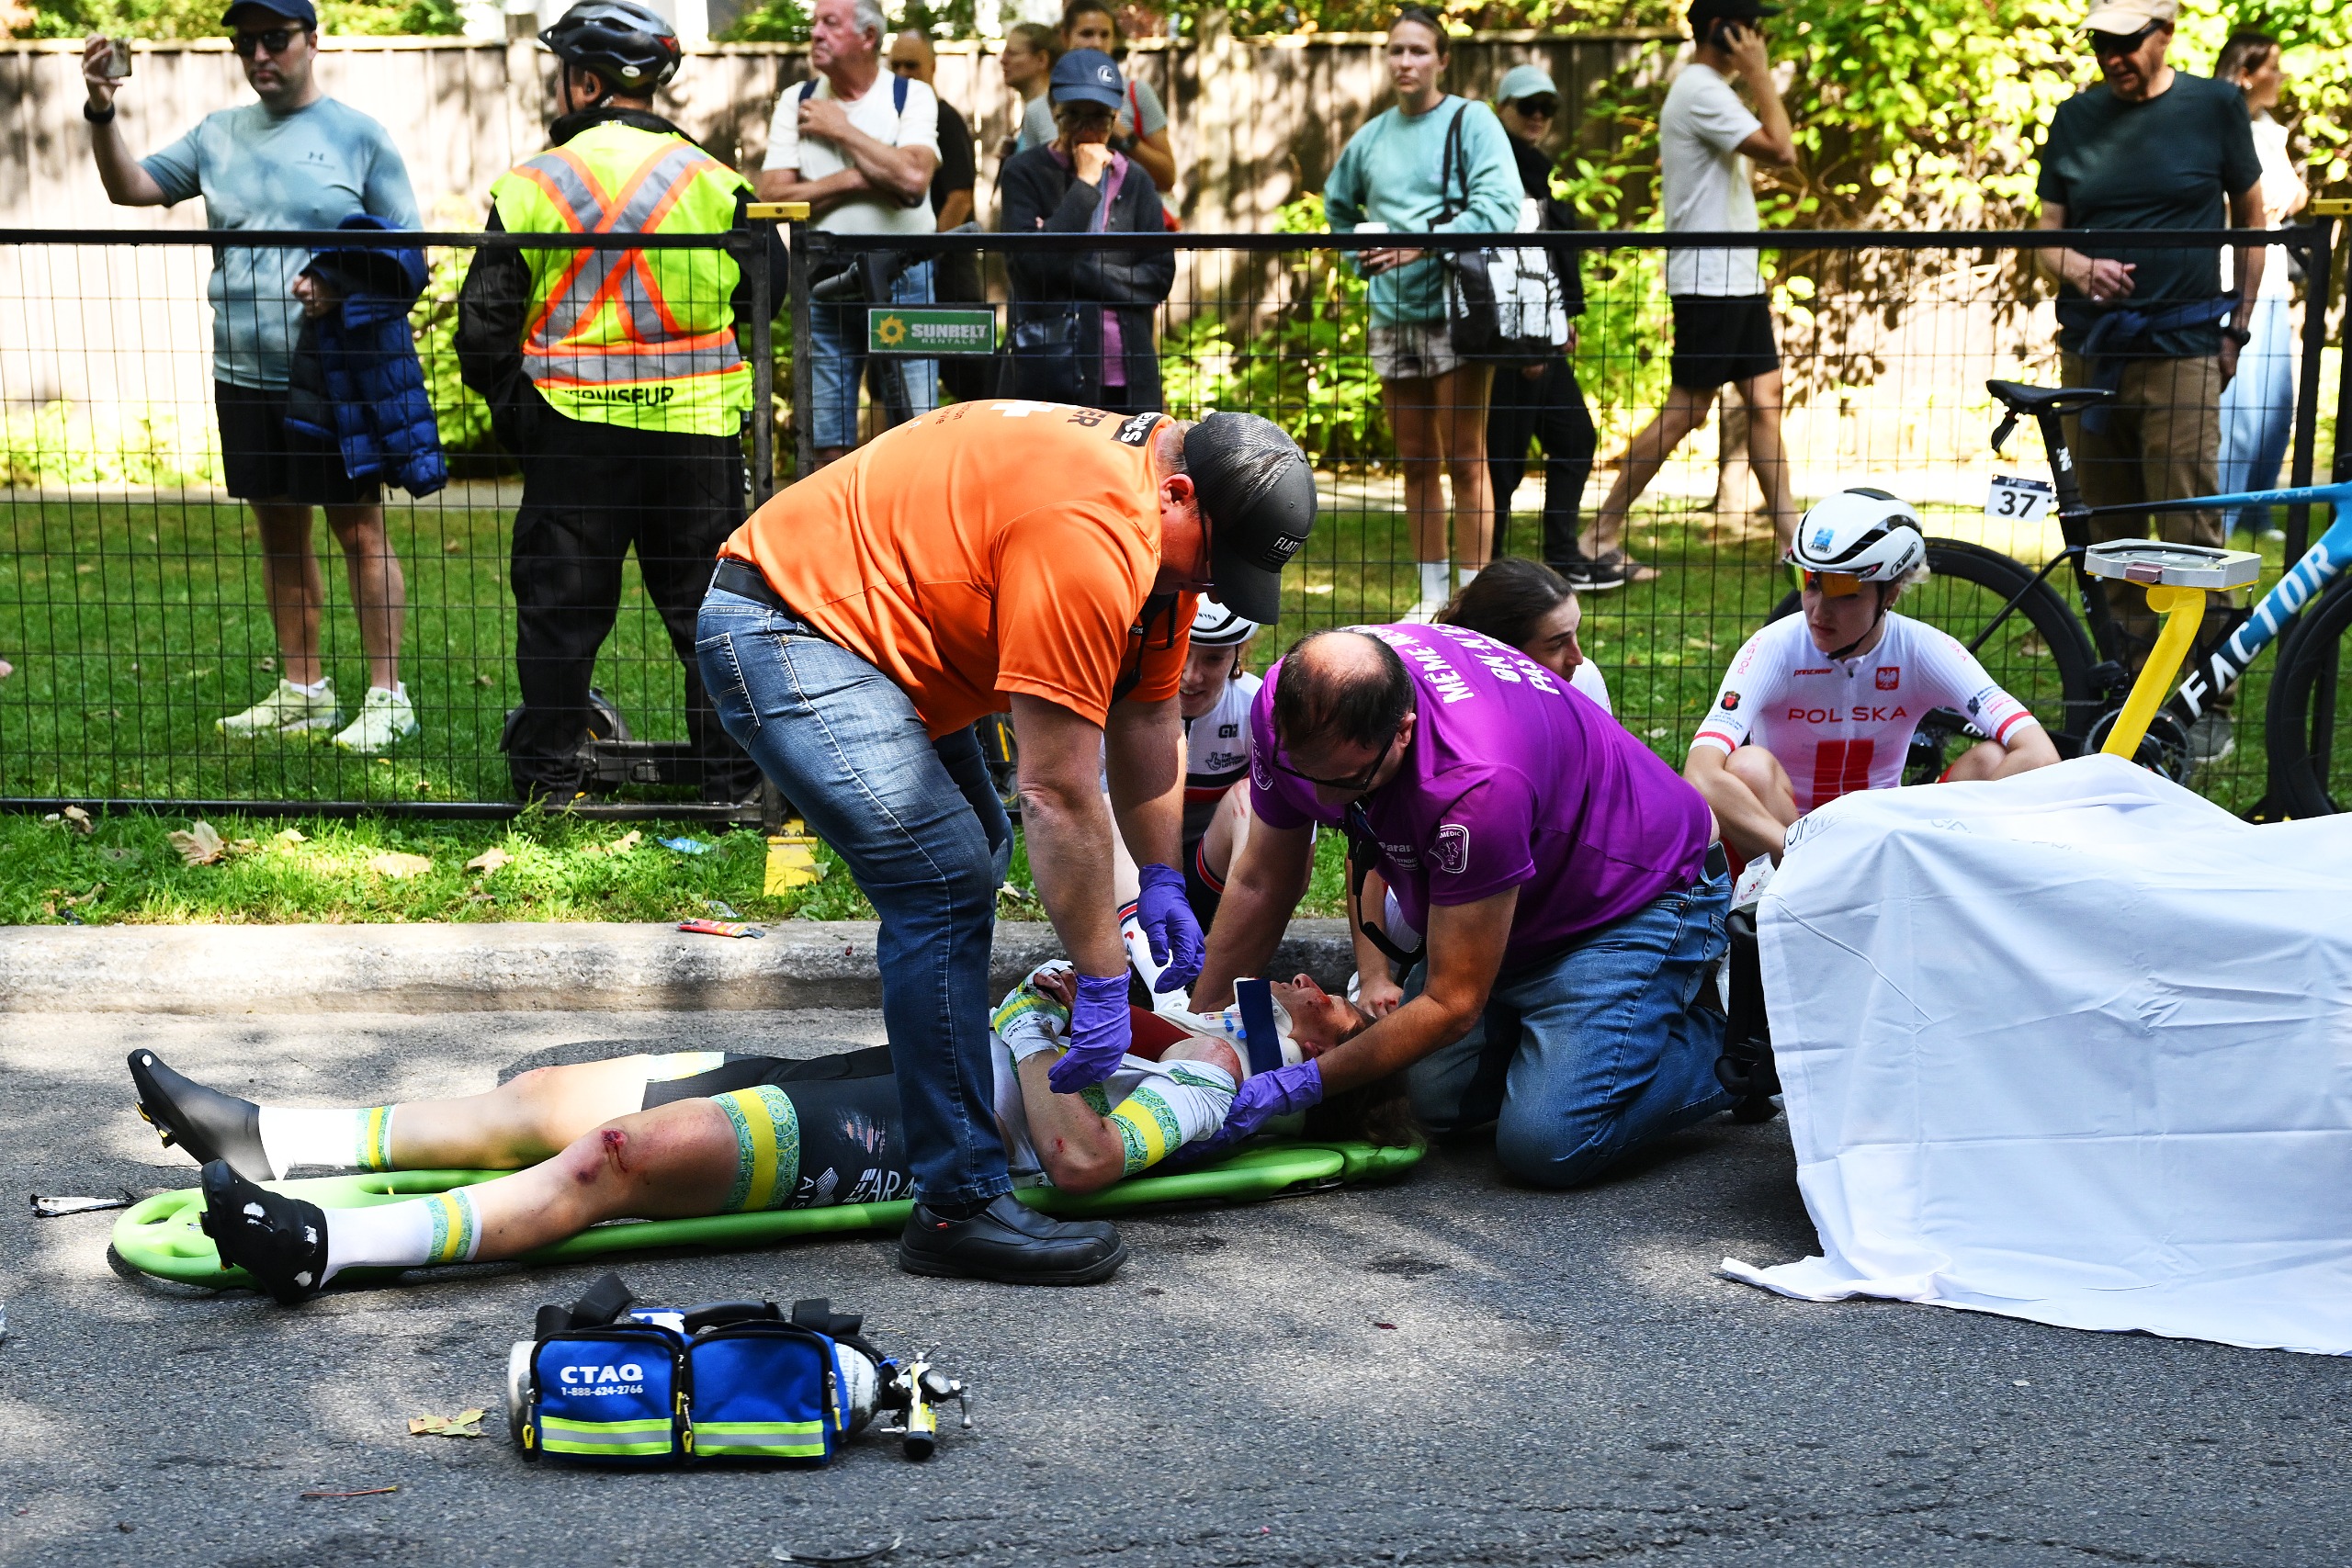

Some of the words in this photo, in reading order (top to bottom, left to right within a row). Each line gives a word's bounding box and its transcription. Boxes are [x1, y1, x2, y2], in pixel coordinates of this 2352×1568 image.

[911, 323, 987, 338] SUNBELT
[922, 337, 977, 345] RENTALS
[1997, 491, 2038, 518] 37
[1273, 536, 1300, 552] FLAT
[2179, 543, 2339, 719] FACTOR
[1788, 705, 1908, 724] POLSKA
[1439, 829, 1462, 839] MÉDIC
[560, 1363, 643, 1383] CTAQ
[560, 1384, 643, 1396] 1-888-624-2766
